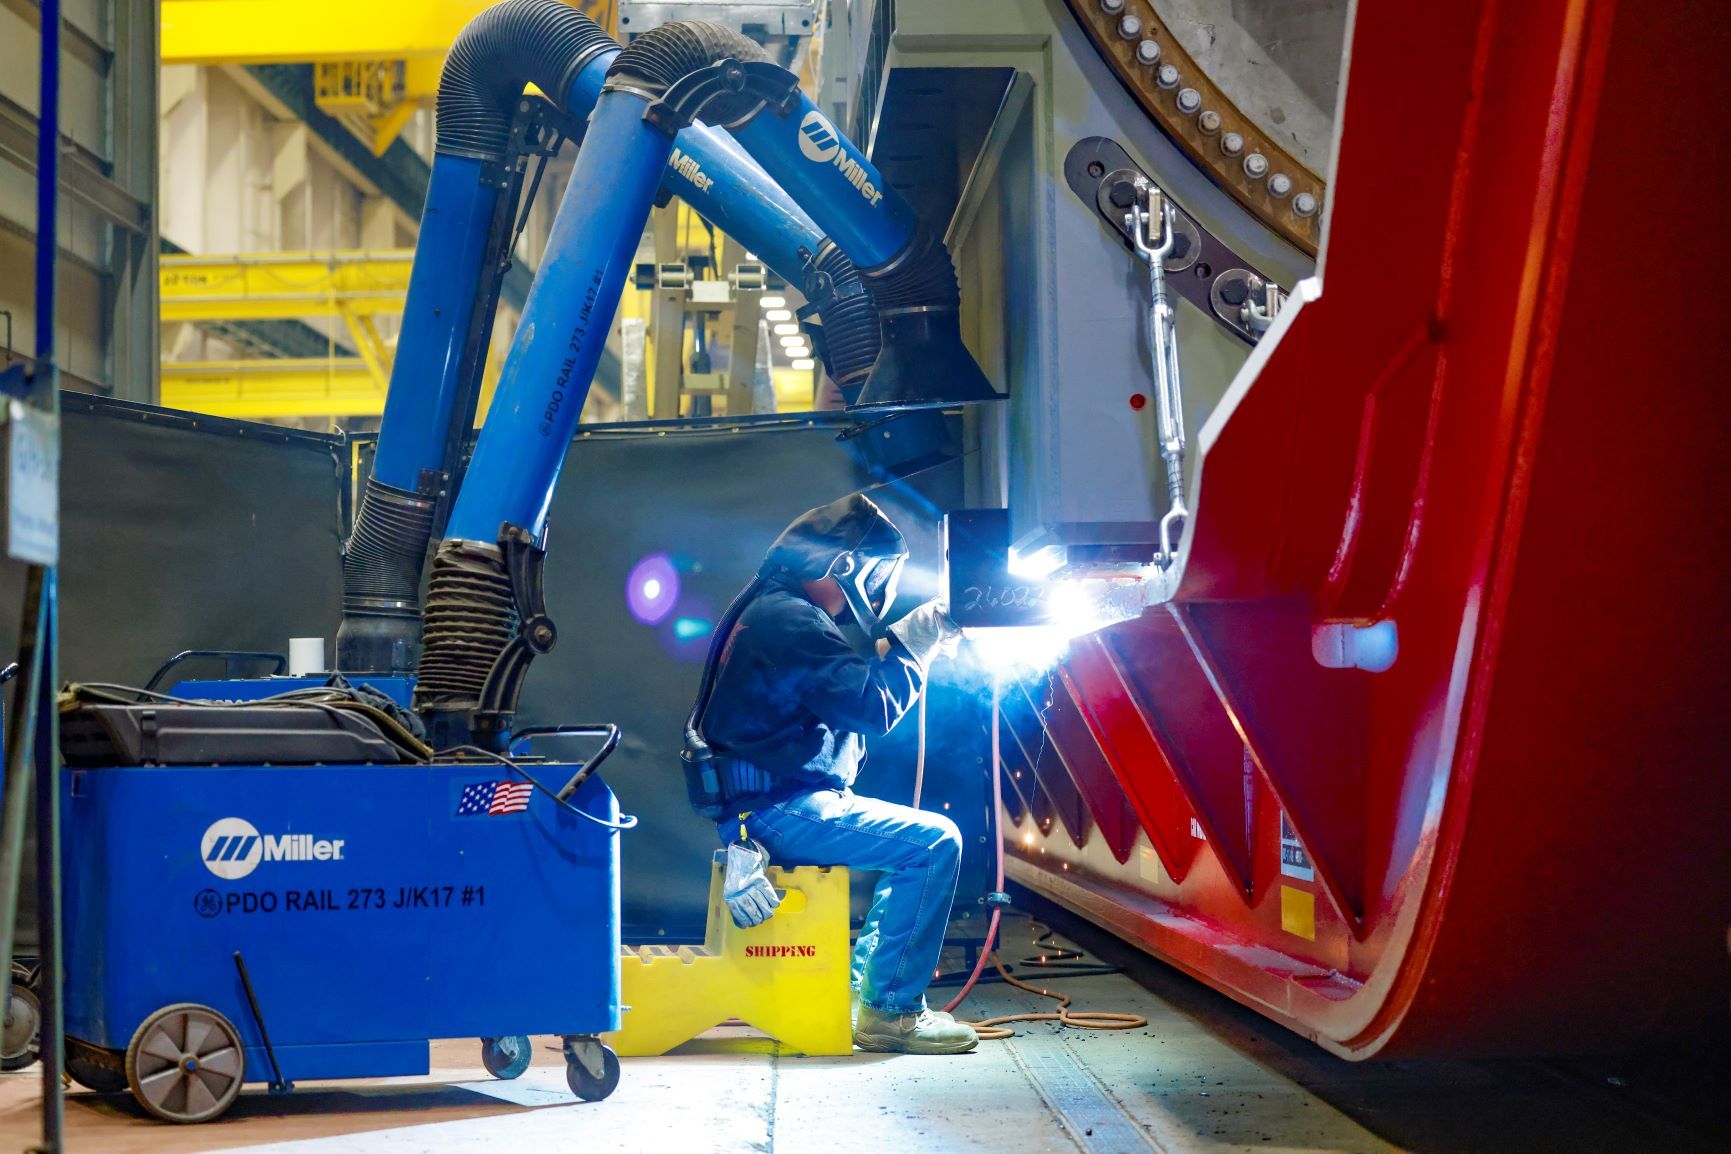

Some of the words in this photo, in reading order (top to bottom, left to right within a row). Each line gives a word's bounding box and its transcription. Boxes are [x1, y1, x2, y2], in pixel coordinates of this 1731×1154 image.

[668, 148, 714, 192] Miller
[832, 148, 883, 206] Miller
[545, 389, 564, 423] PDO
[557, 356, 577, 388] RAIL
[569, 327, 586, 353] 273
[579, 287, 598, 325] J/K17
[592, 269, 605, 285] #1
[264, 834, 345, 861] Miller
[226, 892, 277, 914] PDO
[286, 889, 340, 912] RAIL
[348, 887, 386, 909] 273
[393, 886, 454, 908] J/K17
[461, 885, 486, 906] #1
[745, 945, 816, 957] SHIPPING
